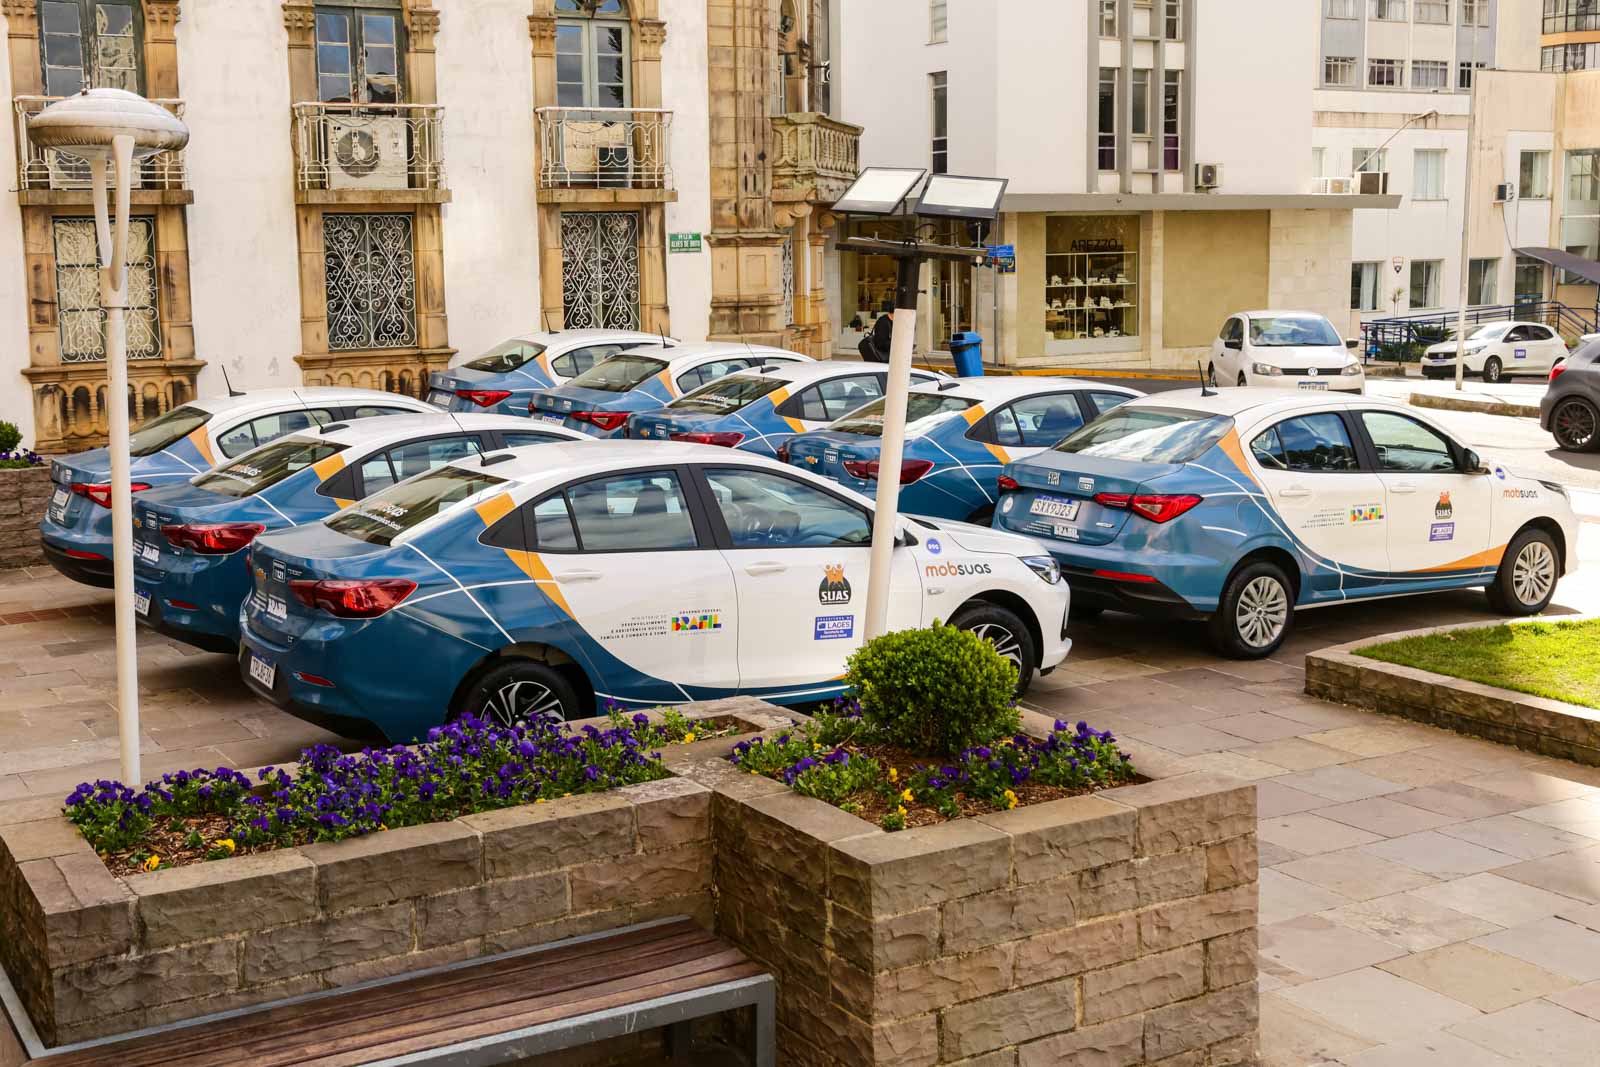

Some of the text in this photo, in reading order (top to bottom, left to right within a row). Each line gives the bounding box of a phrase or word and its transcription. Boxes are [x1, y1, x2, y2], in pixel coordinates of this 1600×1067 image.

[1071, 238, 1117, 252] AREZZO
[1035, 501, 1073, 517] SXX9J23
[1350, 506, 1384, 523] BRASIL
[926, 561, 992, 577] mobsuas
[821, 590, 849, 602] SUAS
[671, 613, 722, 631] BRASIL
[827, 621, 850, 629] LAGES
